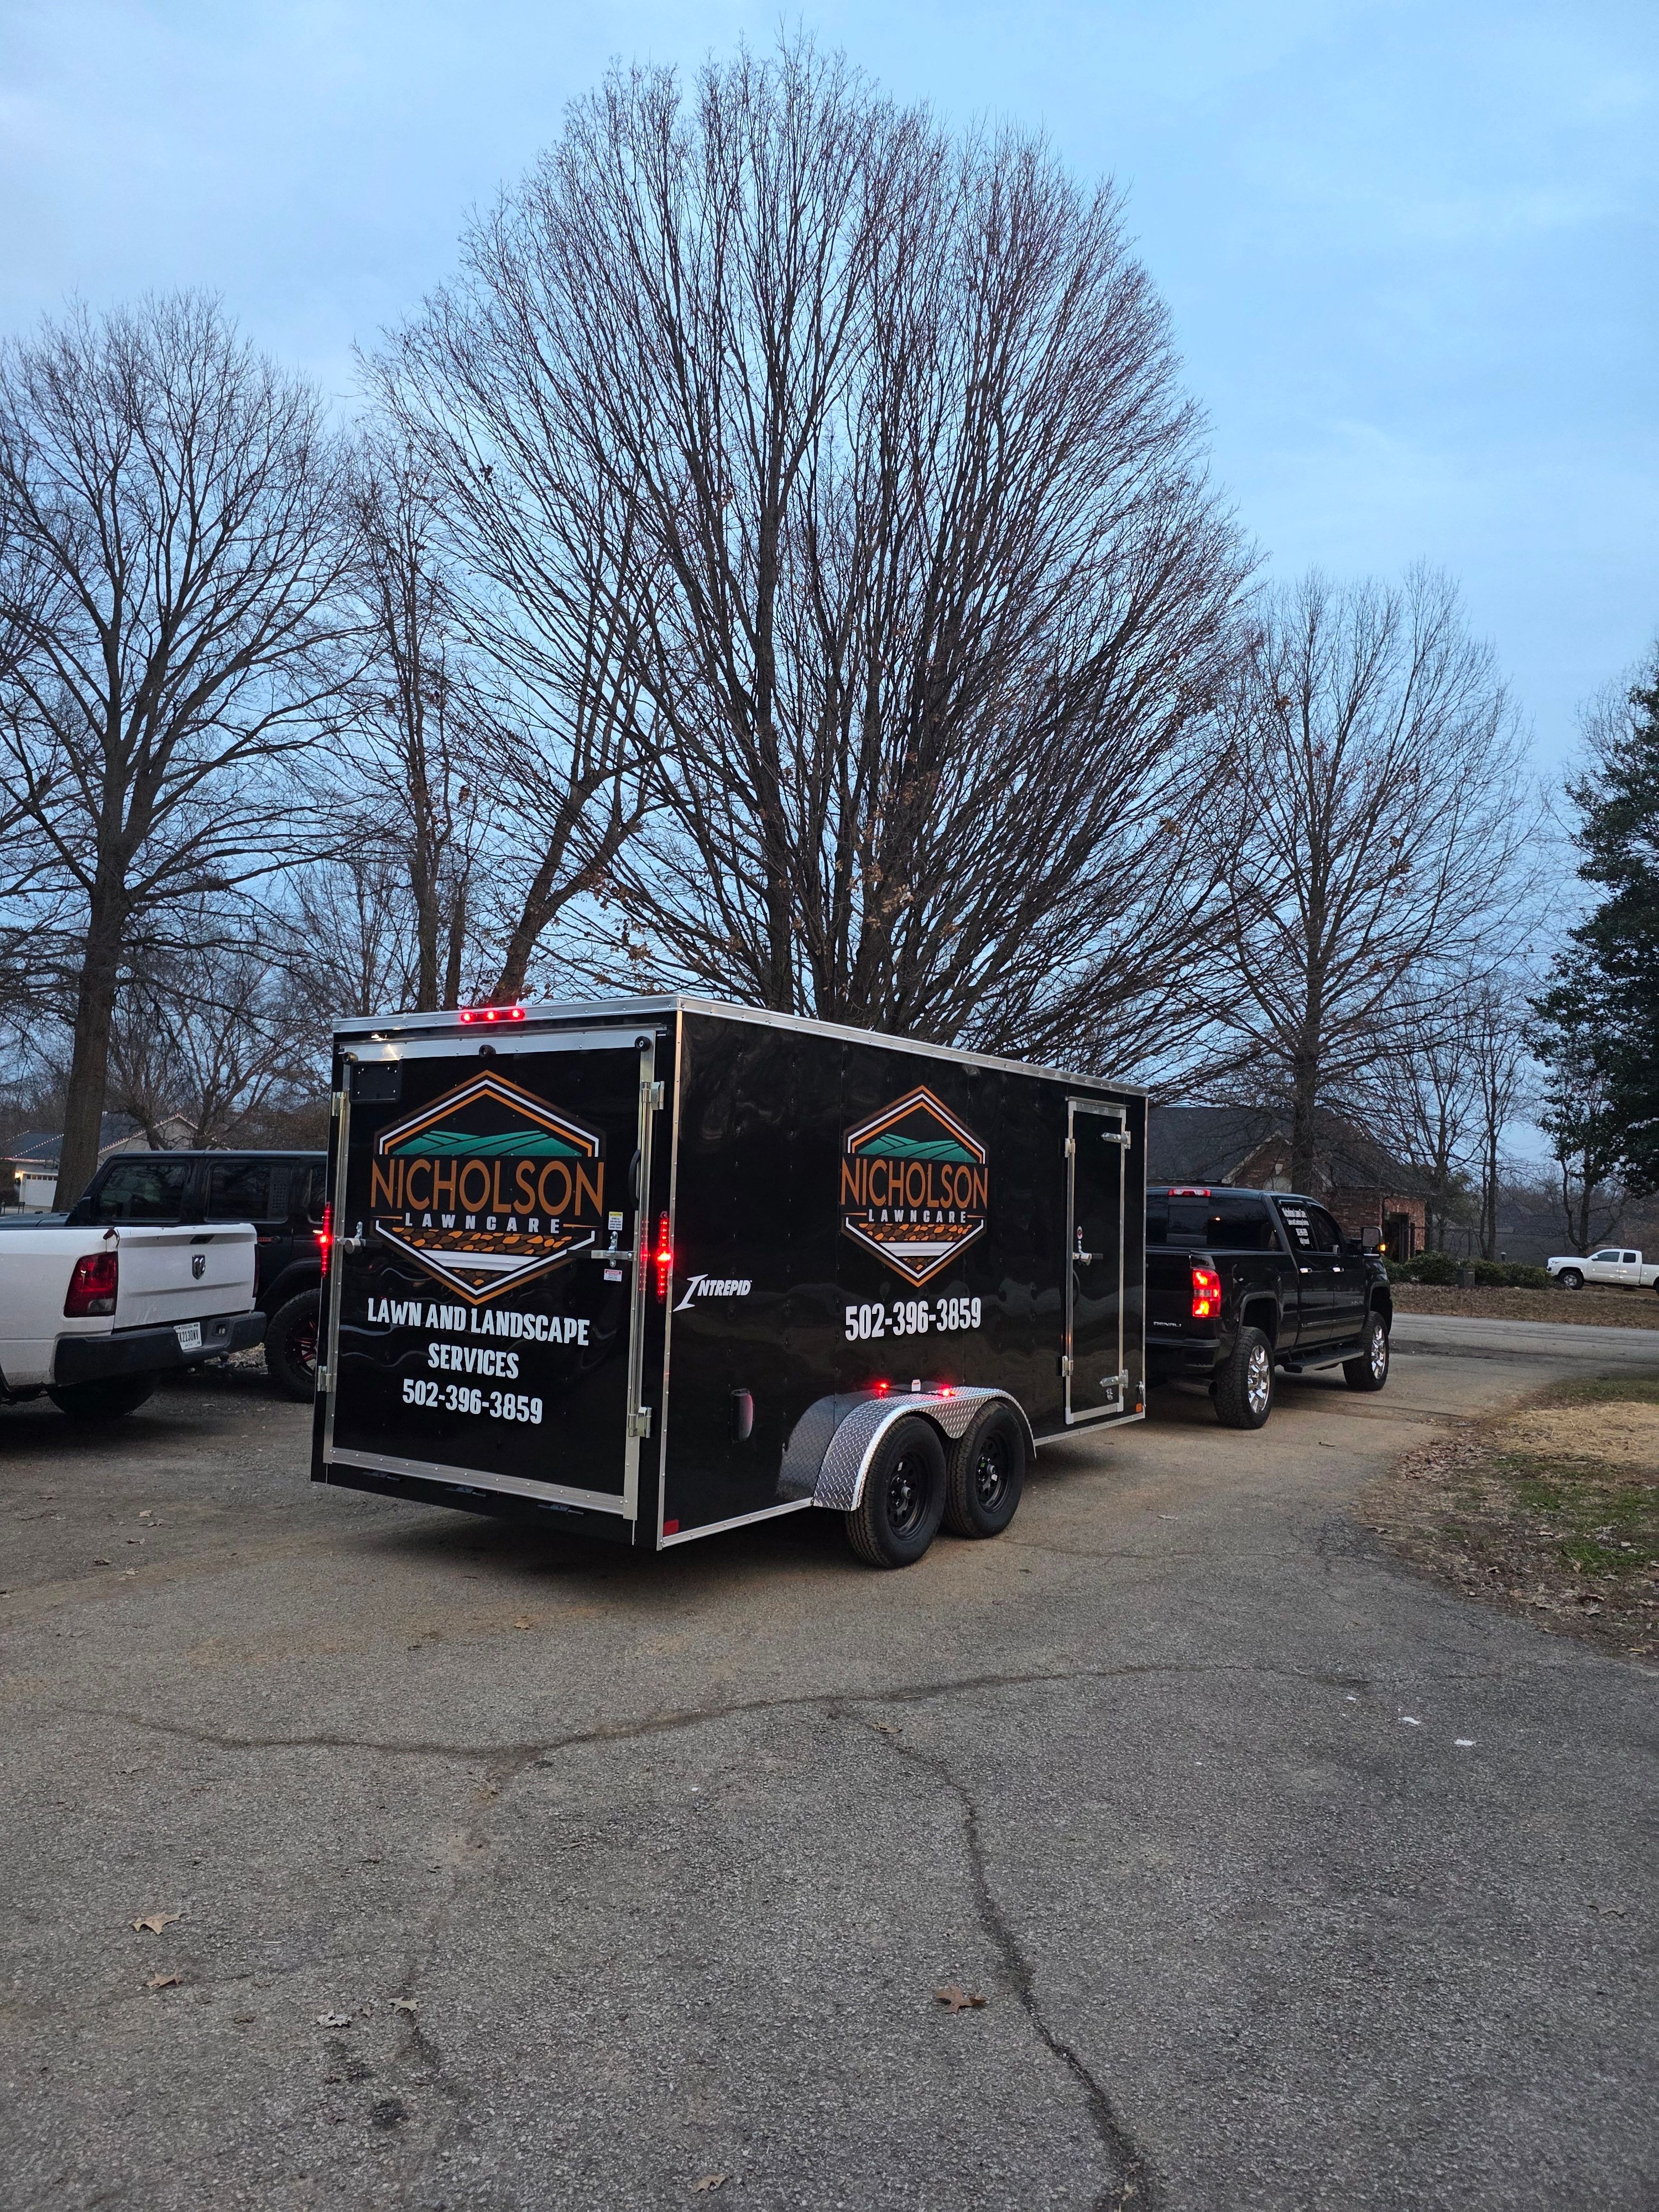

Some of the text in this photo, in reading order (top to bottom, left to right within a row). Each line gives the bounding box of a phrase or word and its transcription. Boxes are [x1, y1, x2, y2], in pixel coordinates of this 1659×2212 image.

[371, 1159, 604, 1217] NICHOLSON
[841, 1156, 989, 1210] NICHOLSON
[405, 1213, 560, 1234] LAWNCARE
[868, 1209, 967, 1224] LAWNCARE
[672, 1274, 751, 1312] INTREPID
[368, 1298, 591, 1347] LAWN AND LANDSCAPE
[845, 1297, 982, 1342] 502-396-3859
[427, 1343, 519, 1380] SERVICES
[402, 1379, 543, 1425] 502-396-3859
